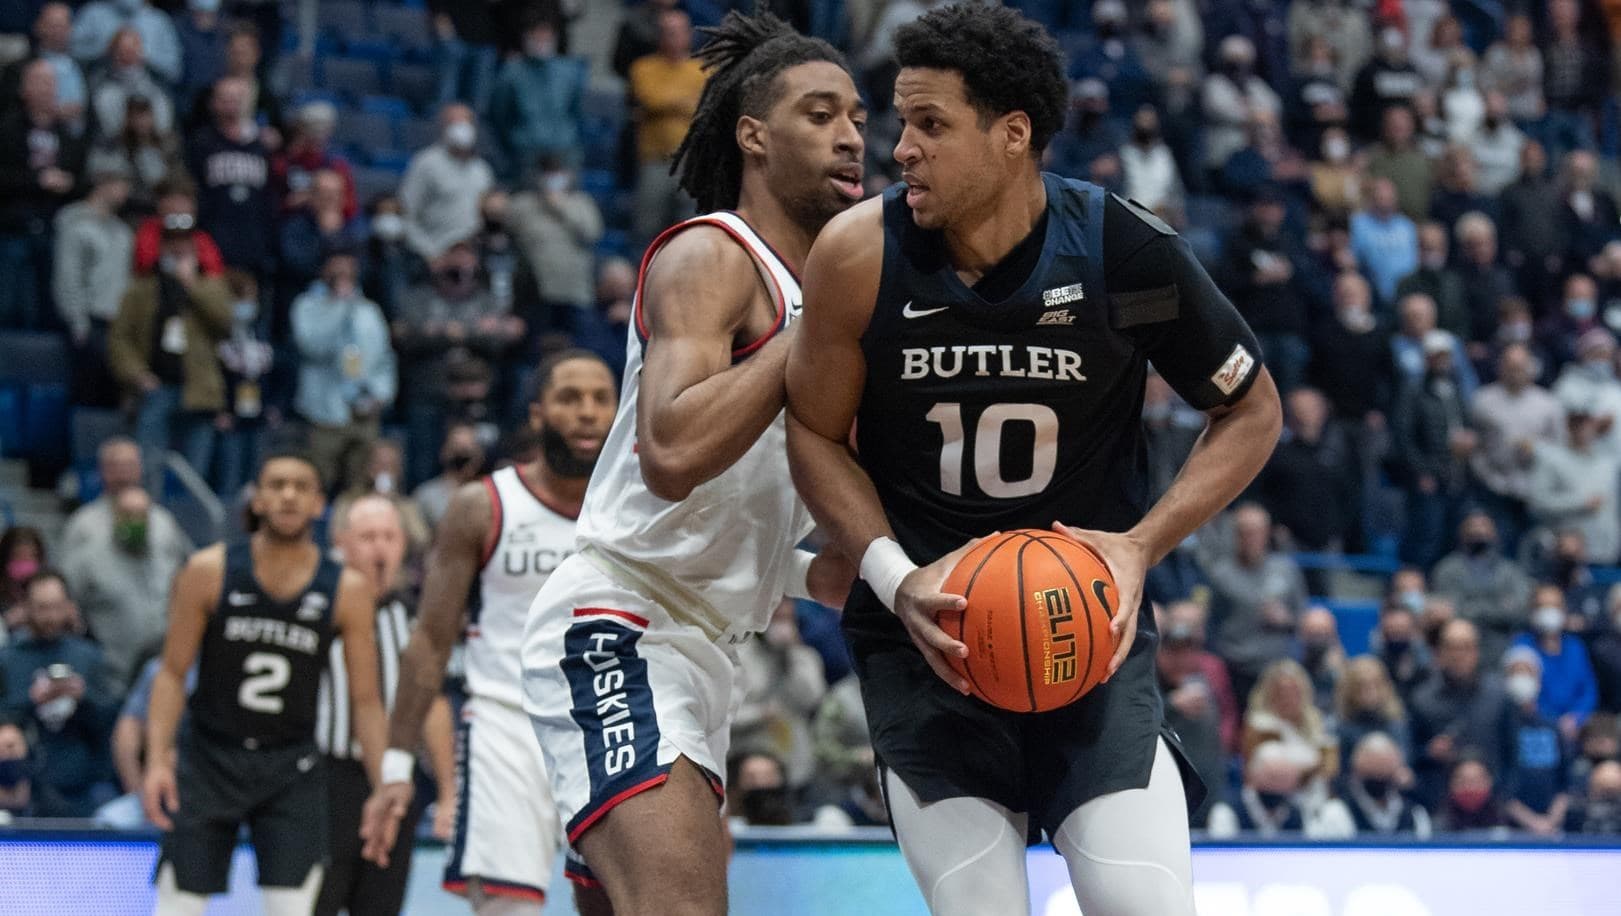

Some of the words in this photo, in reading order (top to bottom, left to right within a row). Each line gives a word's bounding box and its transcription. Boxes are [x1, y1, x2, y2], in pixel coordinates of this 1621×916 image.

[901, 345, 1087, 382] BUTLER
[925, 402, 1059, 499] 10
[224, 616, 319, 655] BUTLER
[238, 652, 291, 714] 2
[583, 633, 636, 776] HUSKIES
